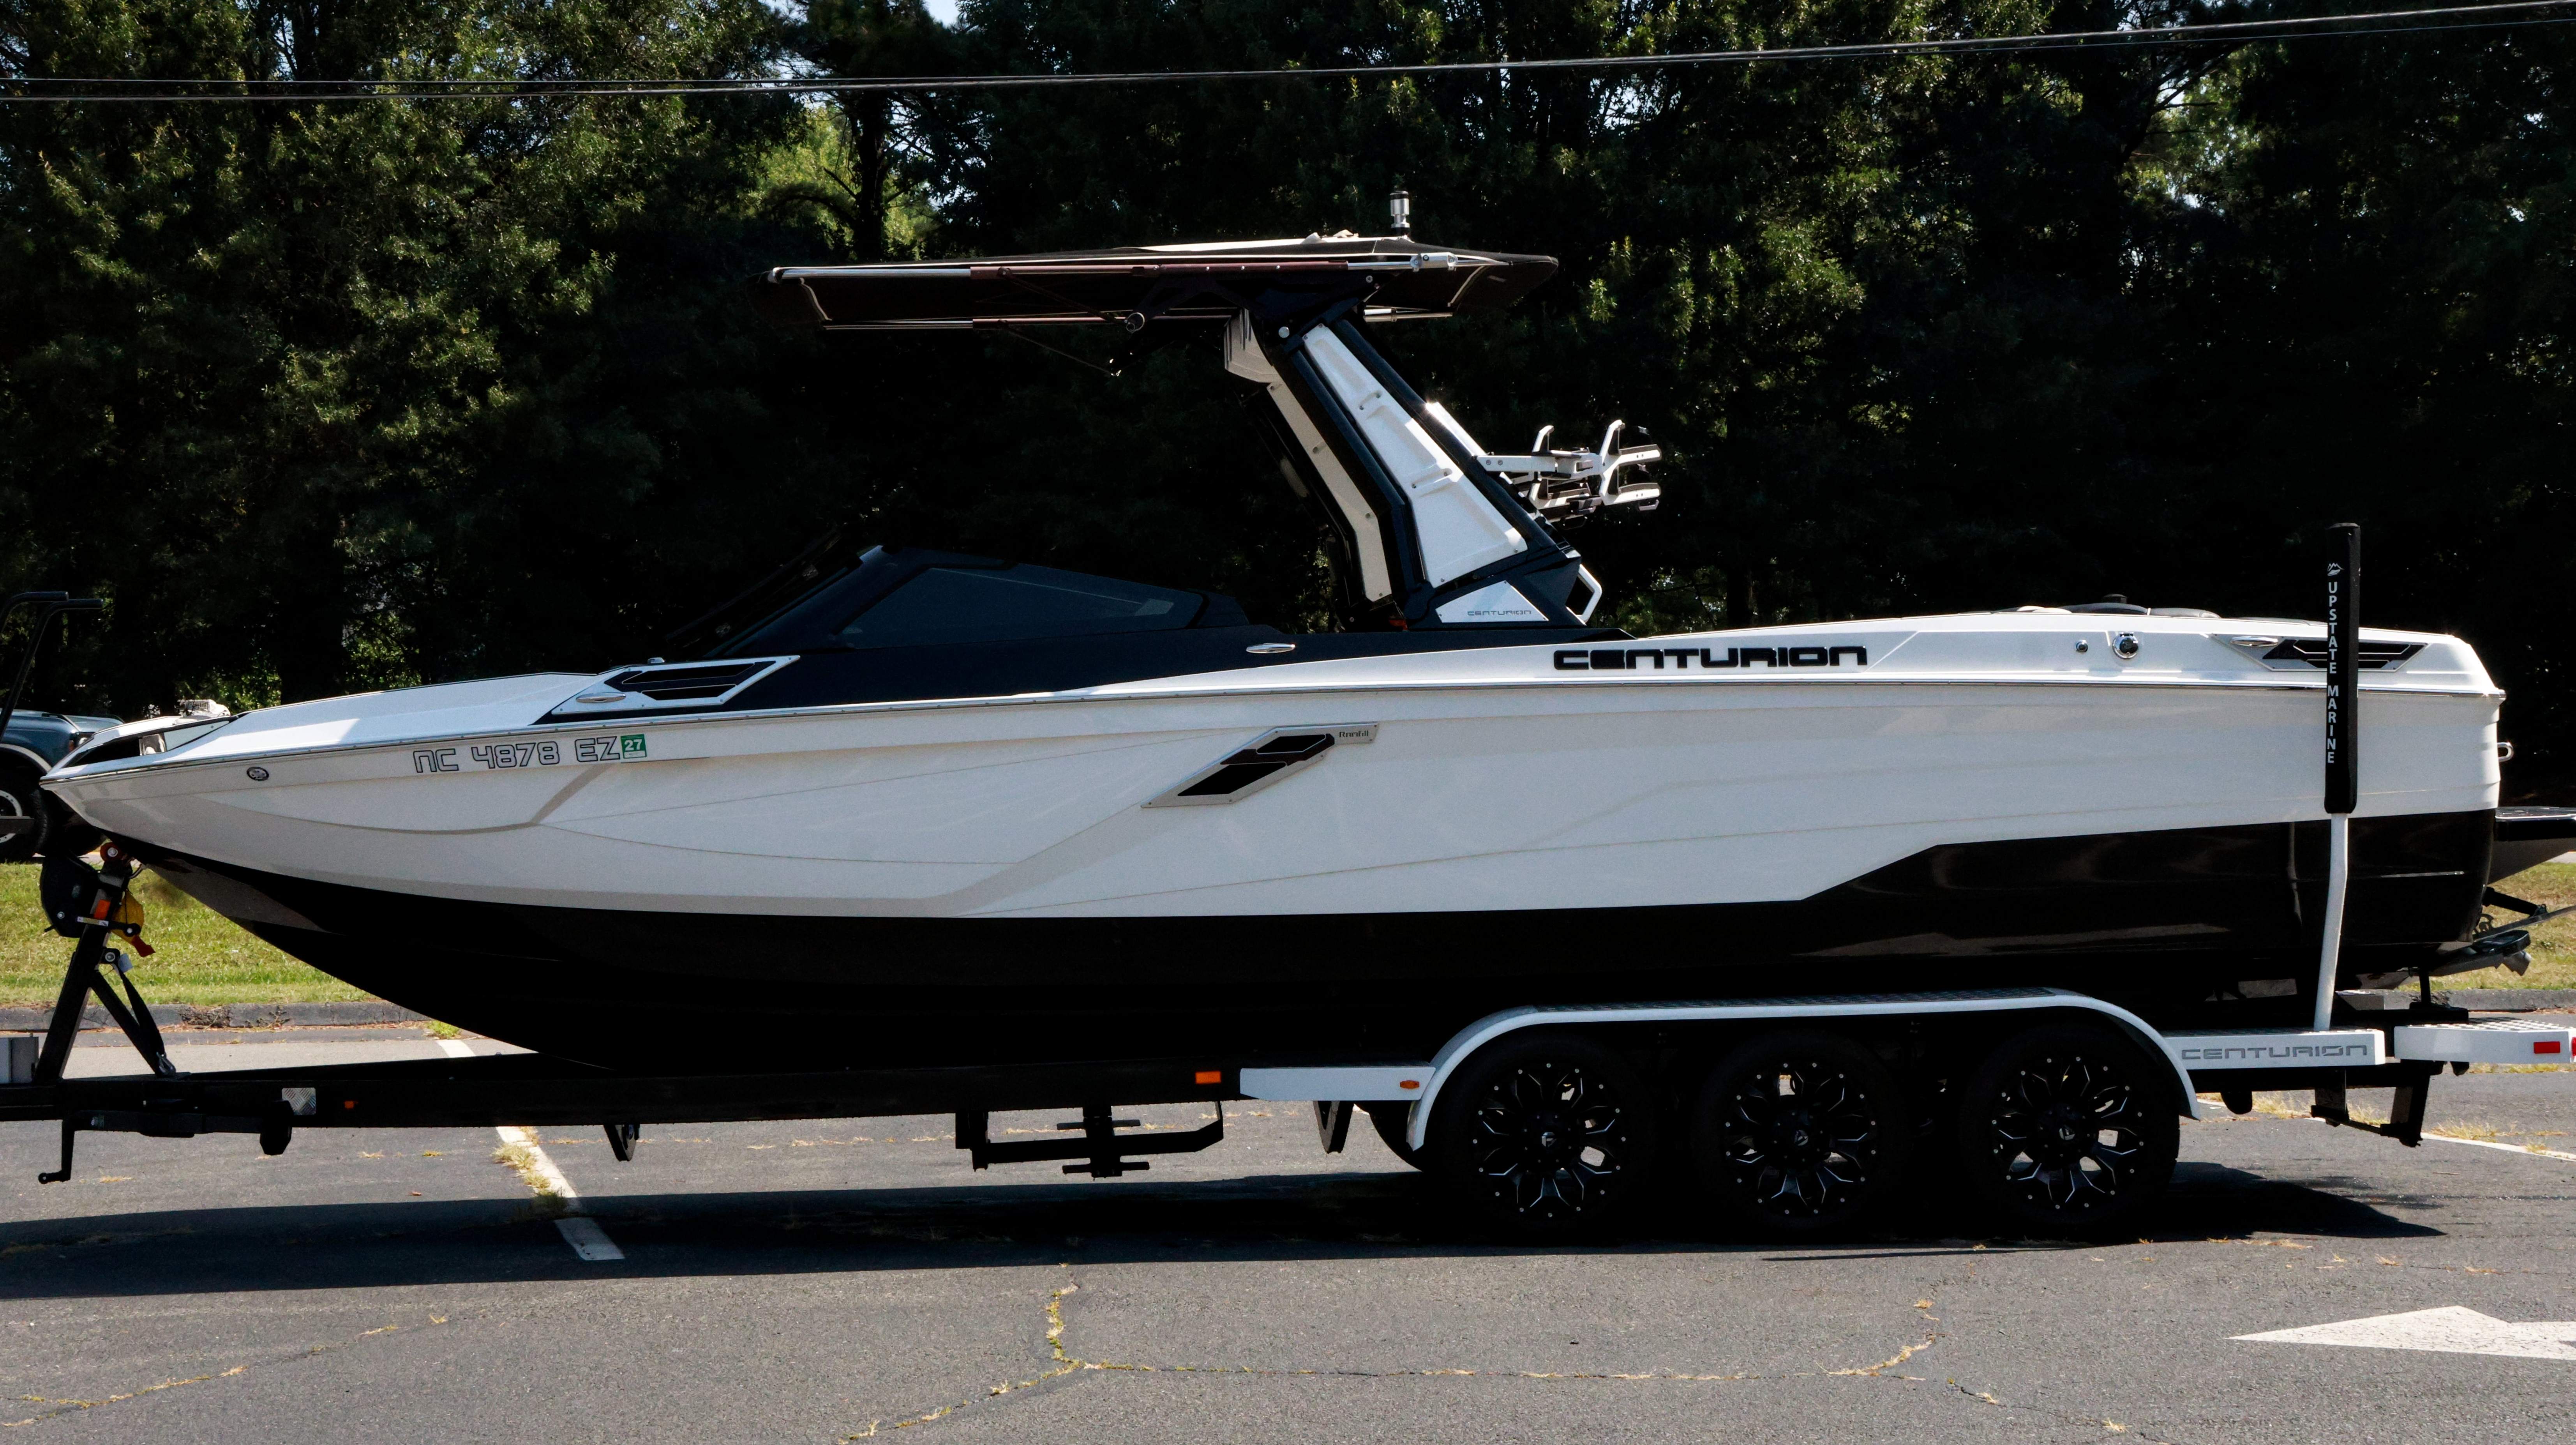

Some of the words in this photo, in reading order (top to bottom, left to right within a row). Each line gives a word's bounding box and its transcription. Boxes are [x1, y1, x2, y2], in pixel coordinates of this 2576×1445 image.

[2328, 582, 2338, 674] UPSTATE
[1553, 645, 1868, 670] CENTURION
[2327, 685, 2339, 763] MARINE
[413, 748, 459, 773] NC
[471, 741, 560, 769] 4878
[574, 736, 621, 763] EZ
[624, 738, 642, 751] 27
[2181, 1045, 2368, 1060] CENTURION
